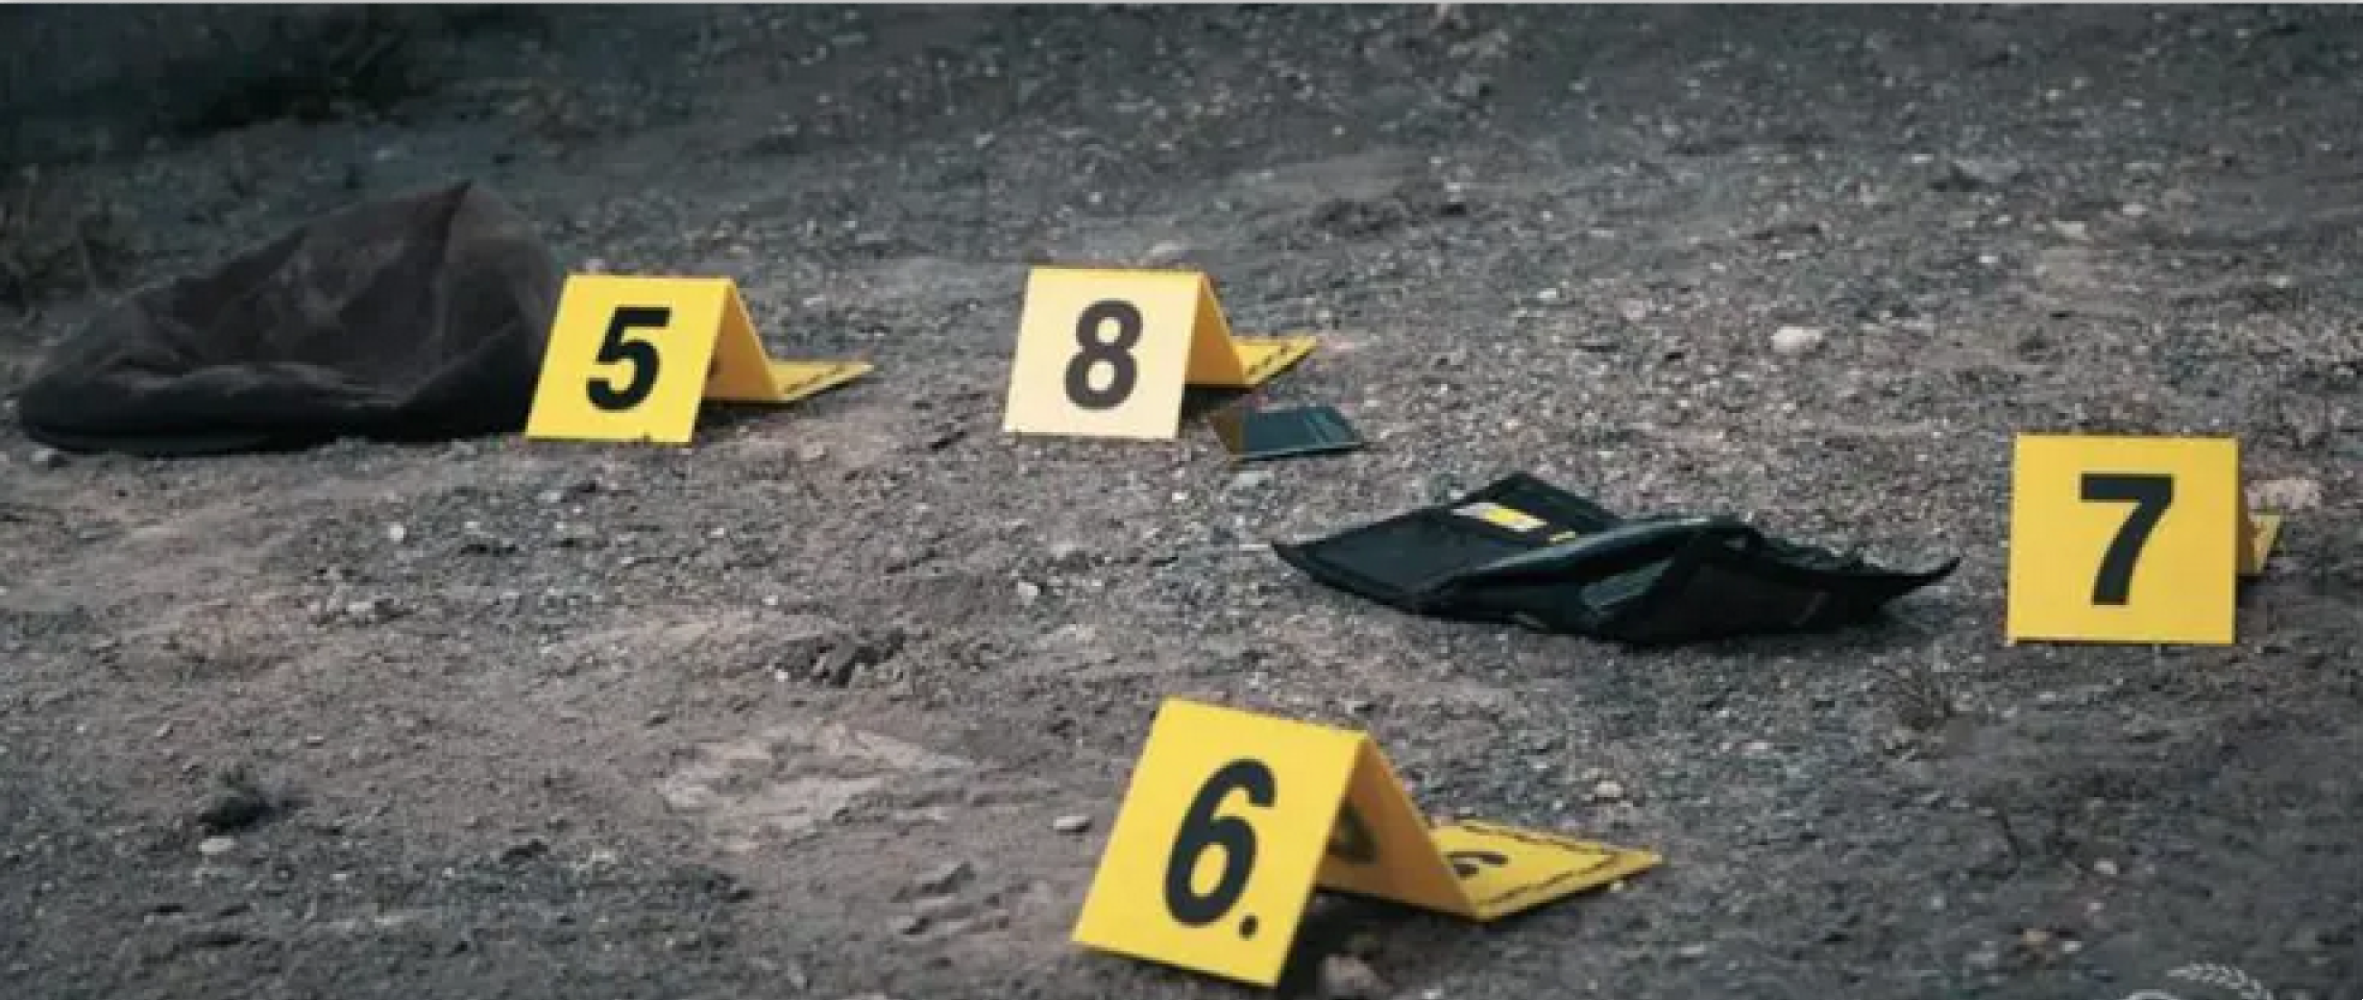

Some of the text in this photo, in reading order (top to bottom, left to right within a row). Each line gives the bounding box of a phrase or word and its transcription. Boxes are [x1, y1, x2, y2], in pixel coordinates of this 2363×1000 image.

[585, 305, 672, 411] 5
[1064, 299, 1144, 411] 8
[2080, 473, 2174, 606] 7
